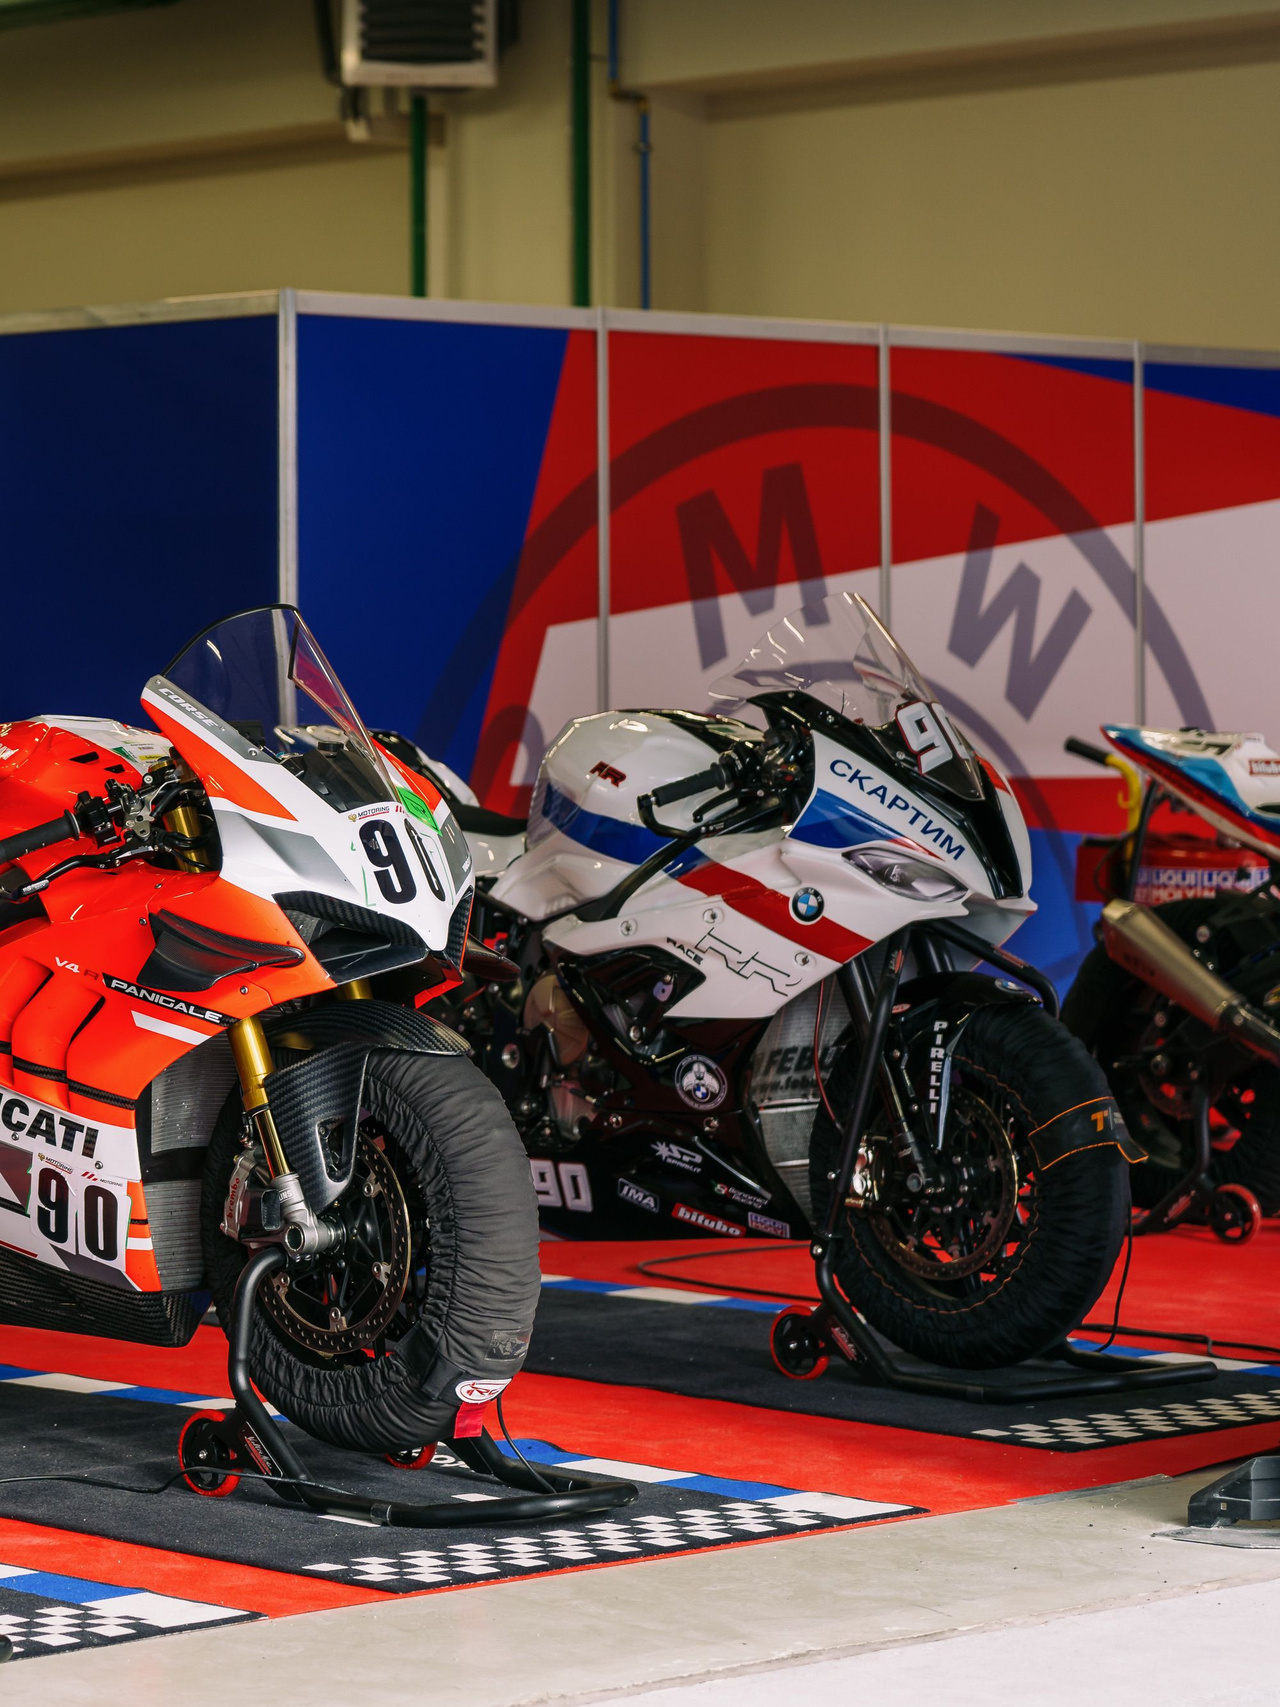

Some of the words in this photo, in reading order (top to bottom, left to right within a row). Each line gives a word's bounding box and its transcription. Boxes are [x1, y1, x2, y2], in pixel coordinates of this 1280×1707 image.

[158, 687, 219, 727] CORSE
[357, 805, 390, 818] MOTORING
[829, 759, 966, 861] СКАРТИМ
[358, 818, 447, 905] 90
[55, 956, 80, 974] V4
[666, 936, 704, 966] RACE
[110, 978, 223, 1024] PANIGALE
[928, 1020, 949, 1114] PIRELLI
[45, 1156, 74, 1175] MOTORING
[529, 1158, 594, 1213] 90
[37, 1167, 119, 1261] 90
[226, 1177, 241, 1219] brembo
[621, 1185, 656, 1208] IMA
[677, 1207, 742, 1237] bitubo
